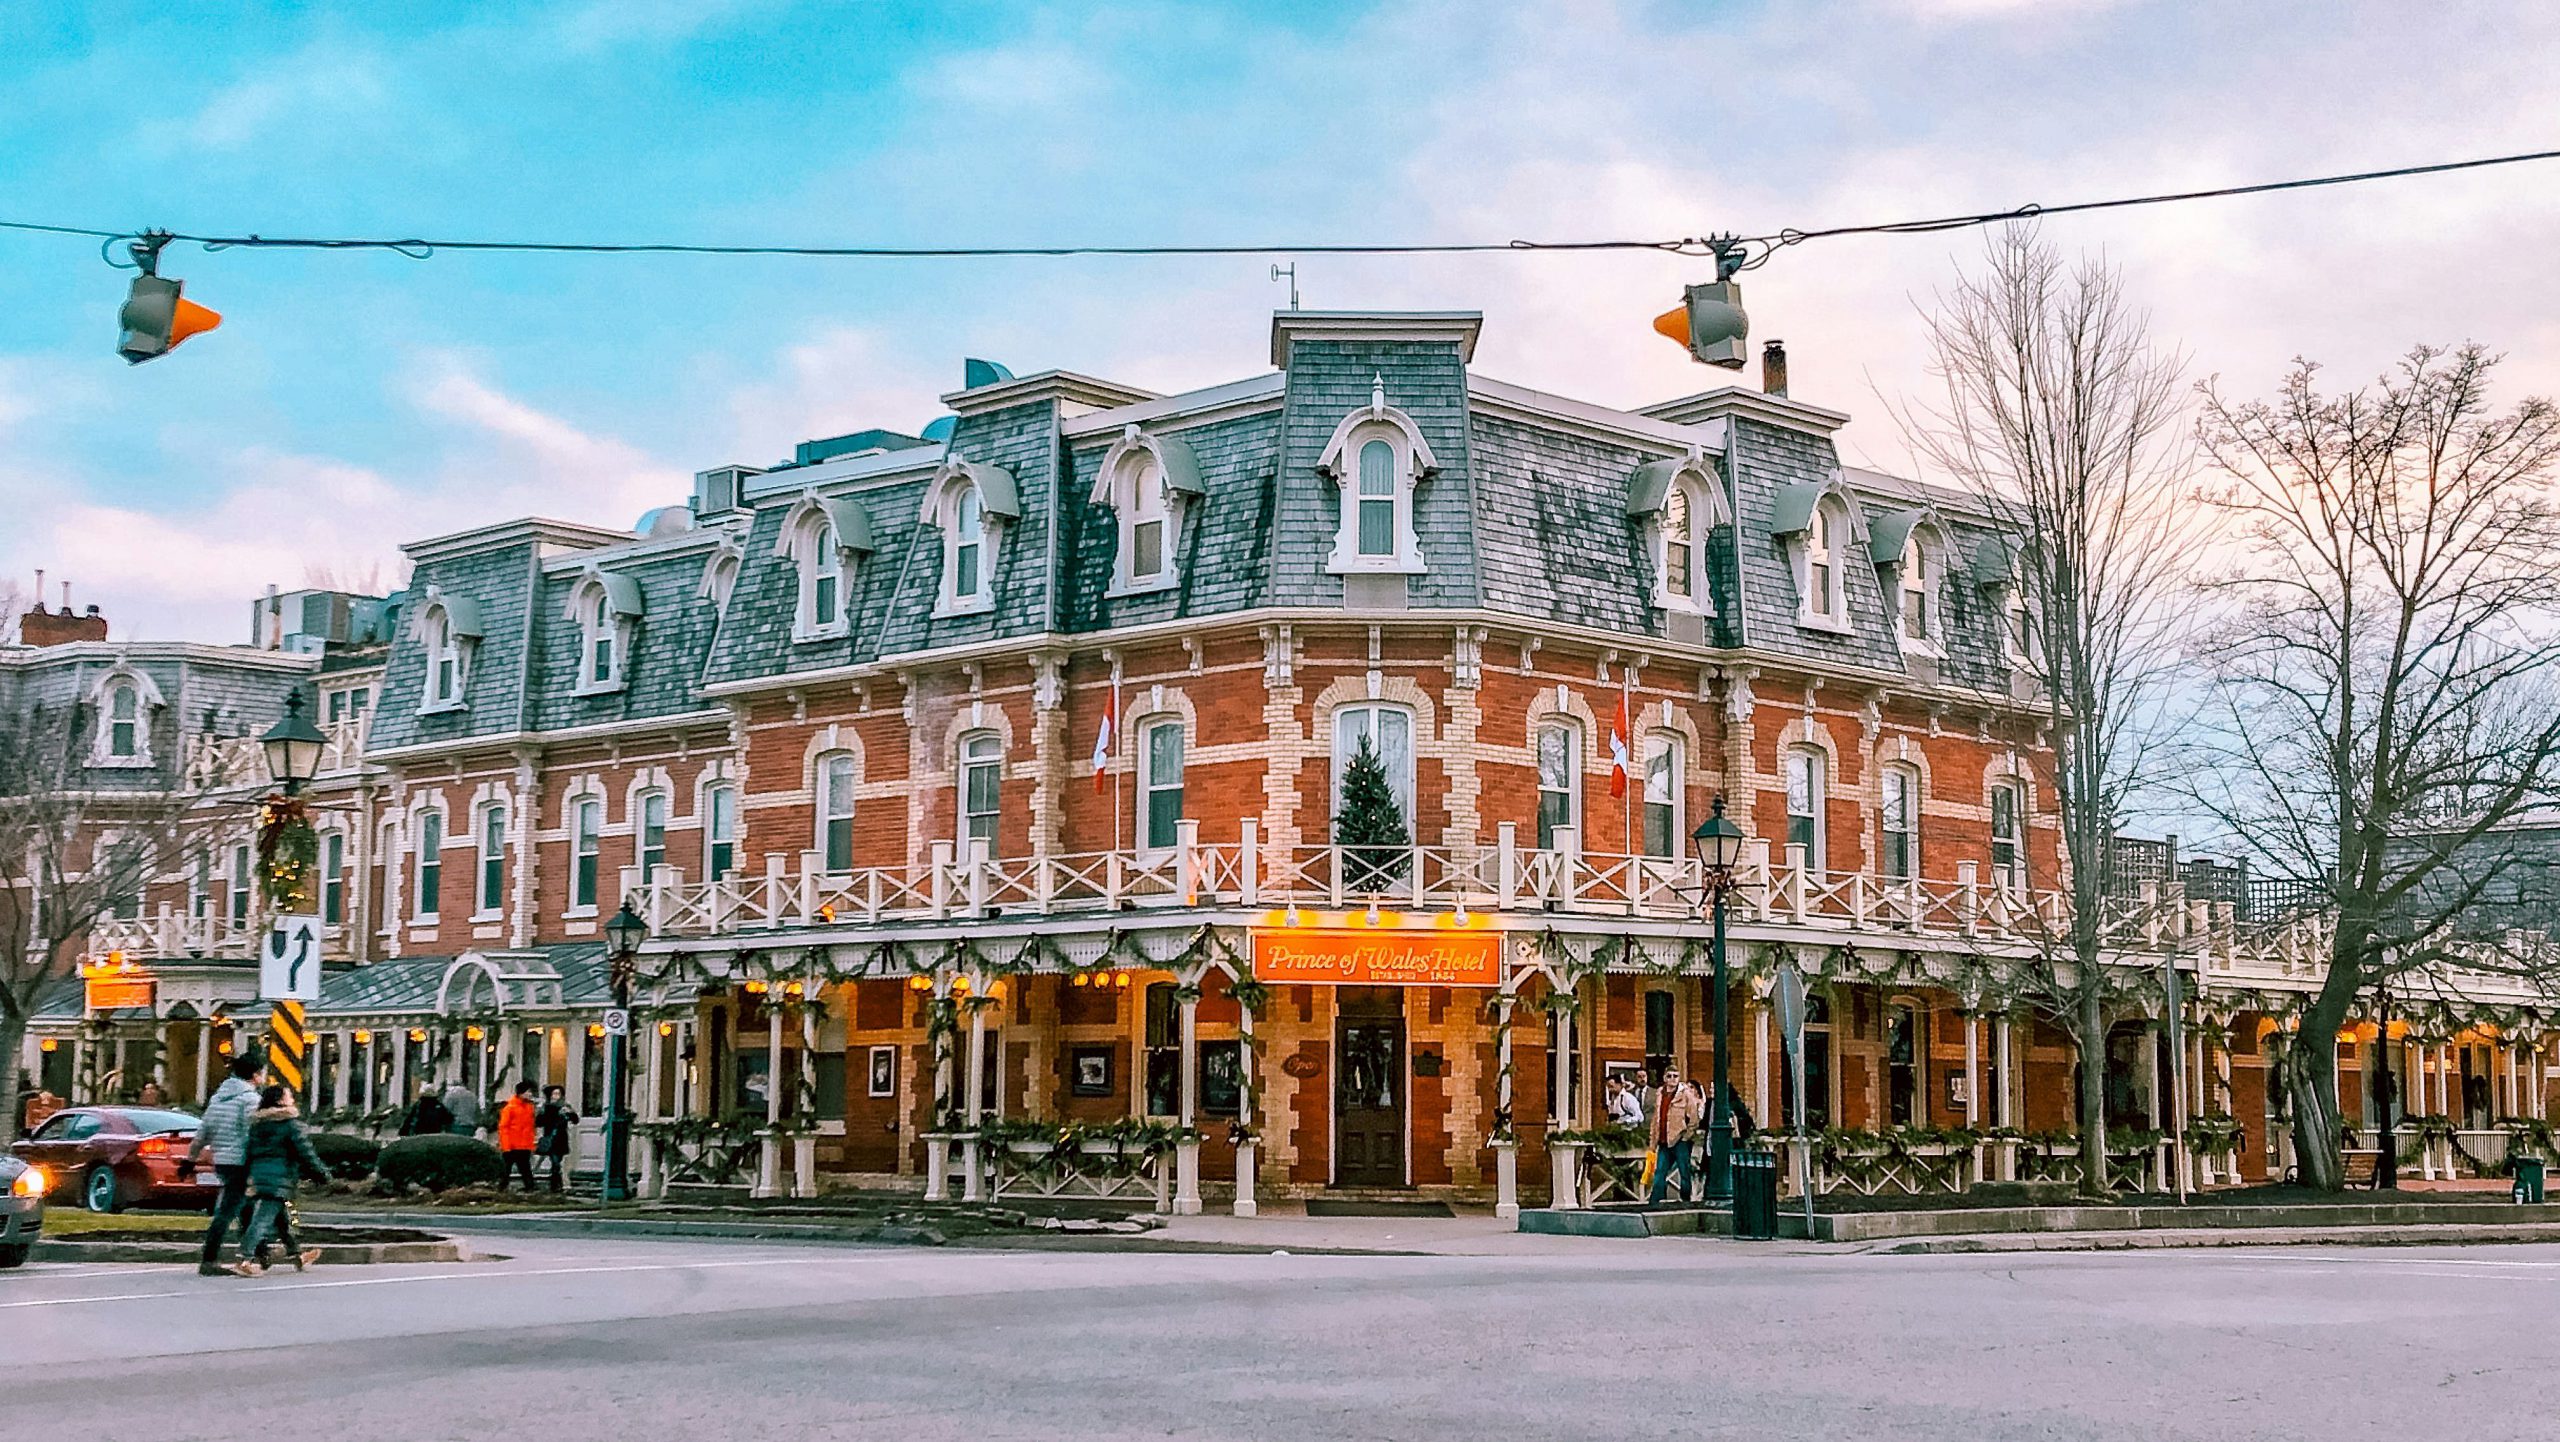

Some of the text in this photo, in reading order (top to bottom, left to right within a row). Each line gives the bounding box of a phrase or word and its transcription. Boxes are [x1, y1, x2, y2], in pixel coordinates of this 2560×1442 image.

[1268, 945, 1488, 975] Prince of Wales Hotel
